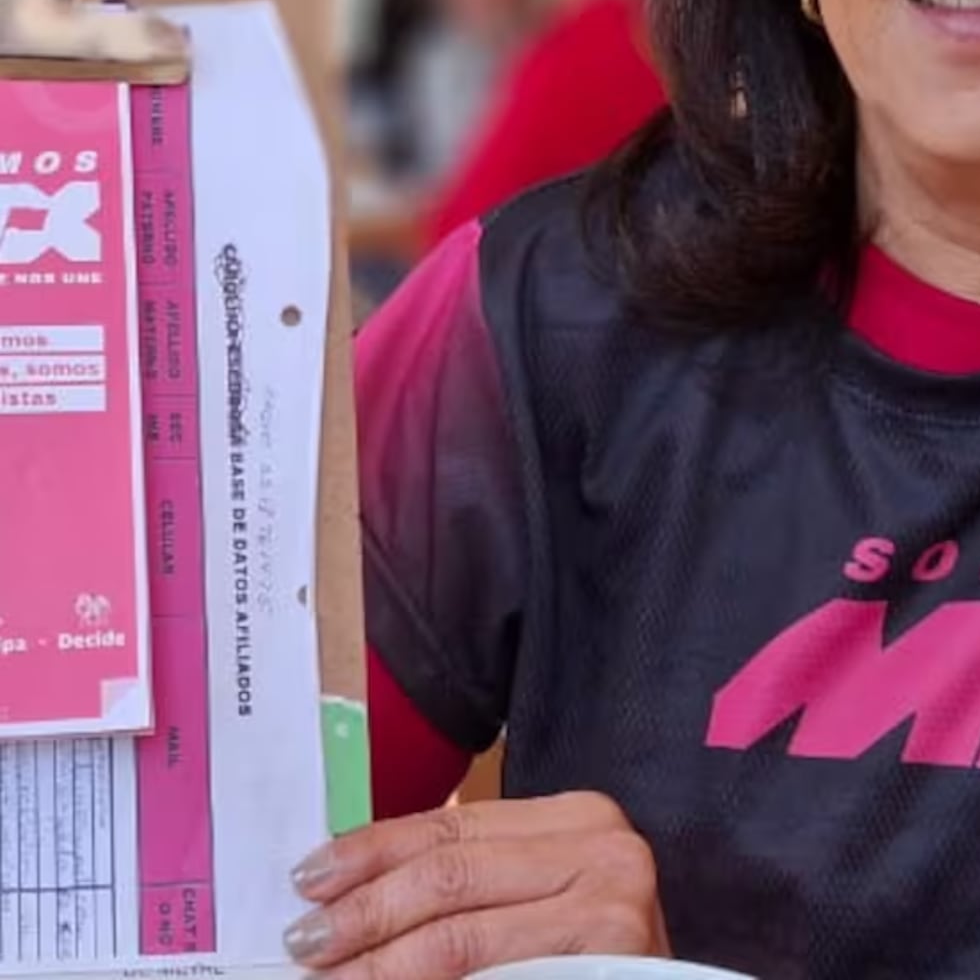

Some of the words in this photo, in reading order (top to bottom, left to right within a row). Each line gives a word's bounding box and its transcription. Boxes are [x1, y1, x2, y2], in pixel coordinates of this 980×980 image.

[230, 452, 245, 501] BASE
[232, 508, 246, 533] DE
[233, 539, 248, 604] DATOS
[58, 630, 125, 650] Decide
[236, 612, 251, 716] AFILIADOS
[182, 888, 197, 937] CHAT
